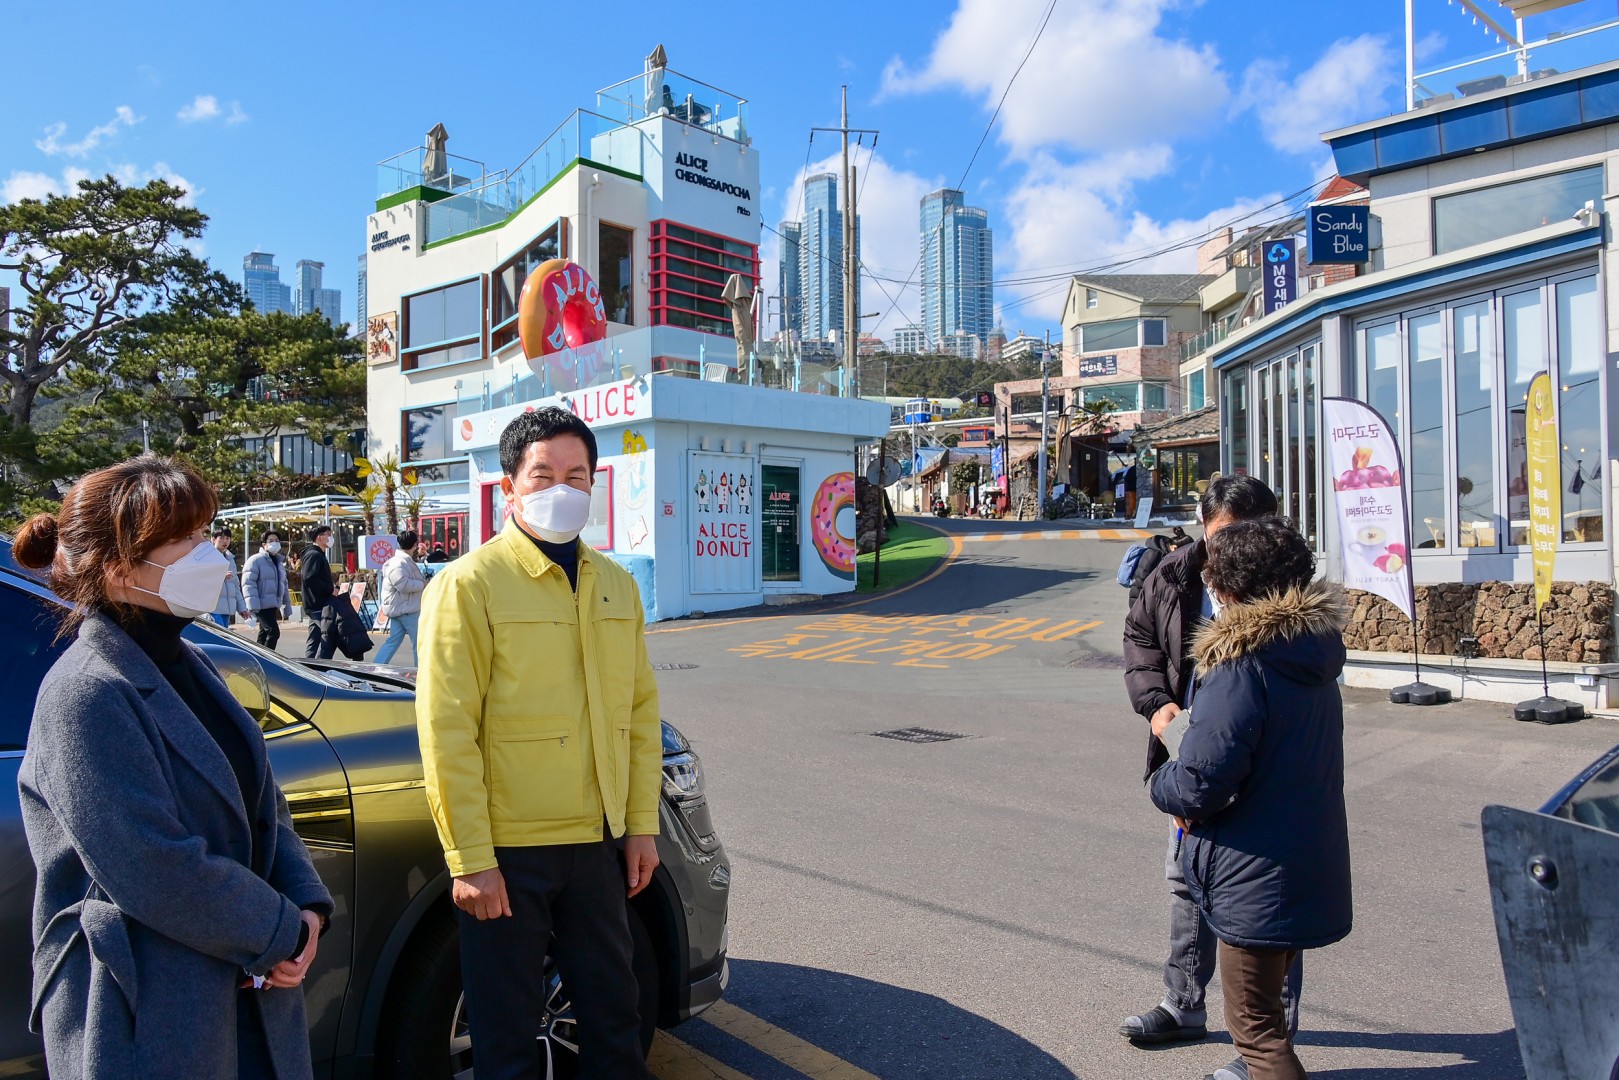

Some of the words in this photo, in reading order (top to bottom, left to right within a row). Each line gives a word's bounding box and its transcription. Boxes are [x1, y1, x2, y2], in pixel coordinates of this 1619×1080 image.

[675, 152, 708, 173] ALICE
[675, 169, 750, 200] CHEONGSAPOCHA
[1317, 213, 1362, 233] Sandy
[1333, 235, 1364, 254] Blue
[552, 268, 605, 321] ALICE
[570, 384, 636, 423] ALICE
[769, 492, 791, 501] ALICE
[699, 522, 749, 539] ALICE
[372, 541, 392, 552] ALICE
[696, 540, 752, 557] DONUT
